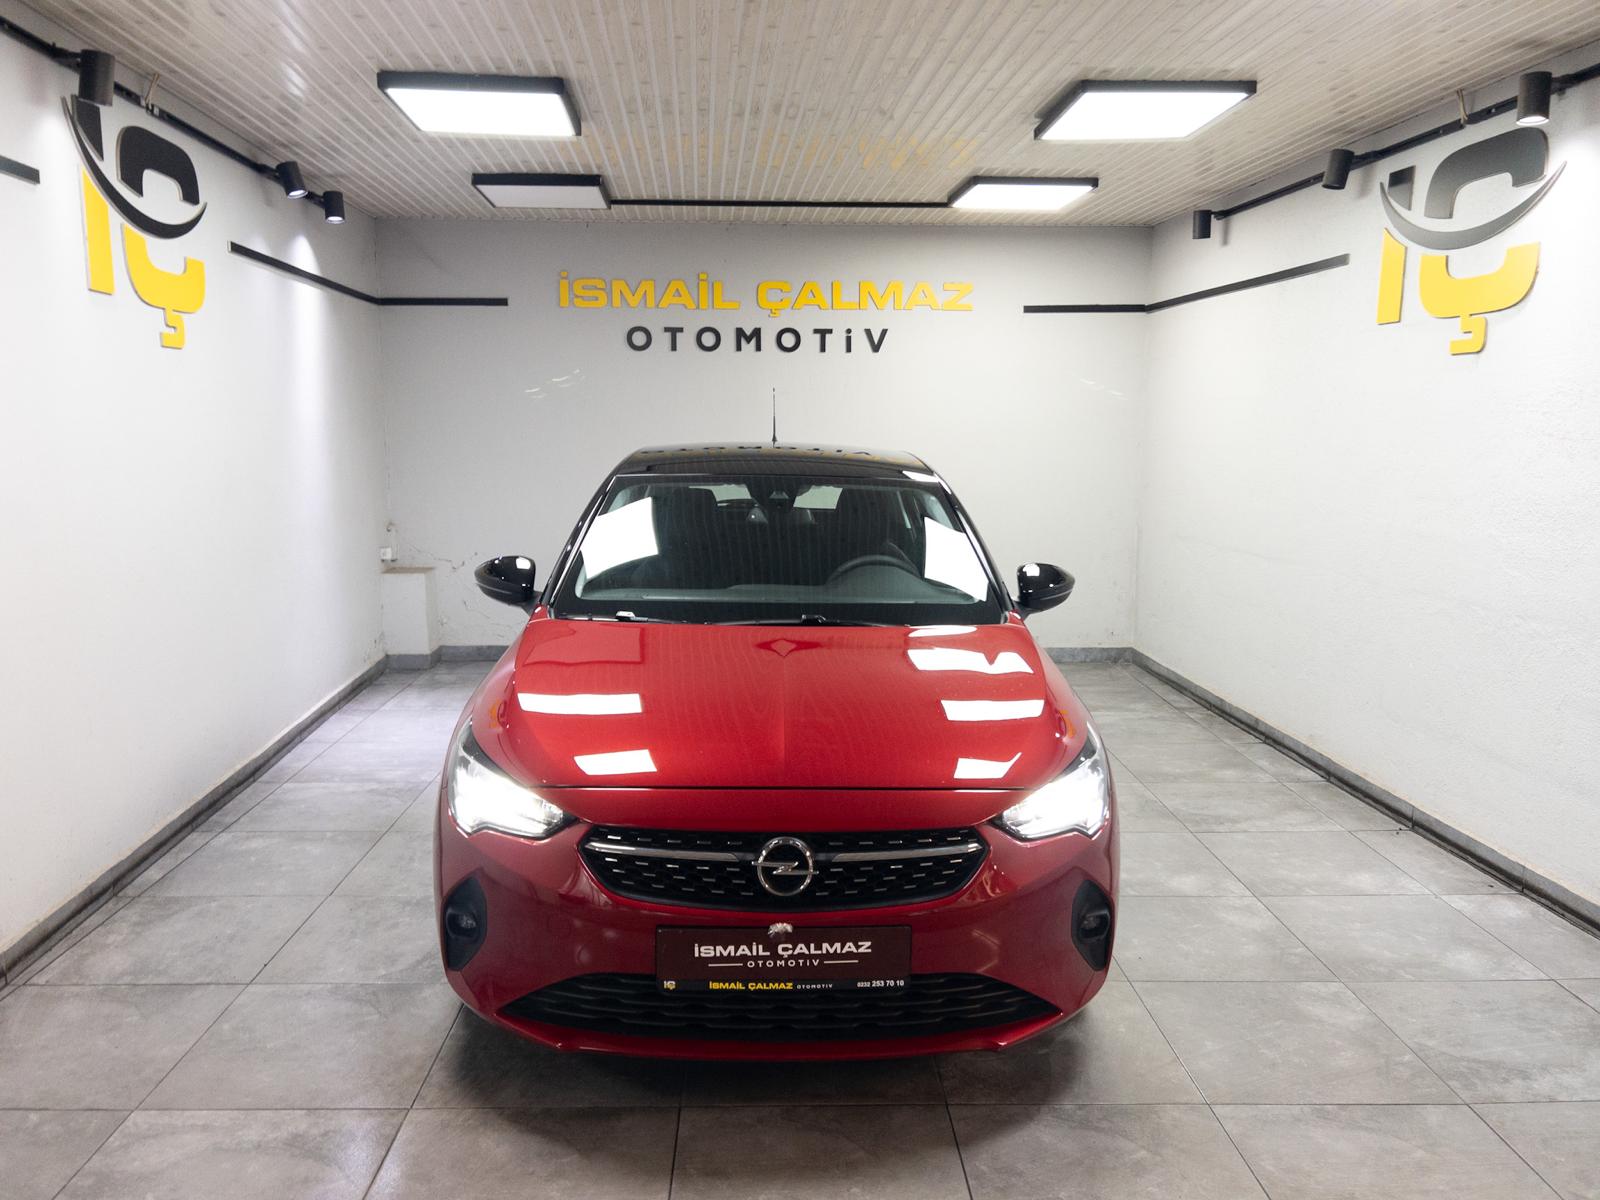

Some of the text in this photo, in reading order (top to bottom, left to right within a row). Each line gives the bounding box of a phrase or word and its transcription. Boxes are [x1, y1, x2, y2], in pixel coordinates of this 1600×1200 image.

[757, 279, 974, 318] ÇALMAZ
[777, 941, 873, 959] ÇALMAZ
[748, 982, 793, 991] ÇALMAZ
